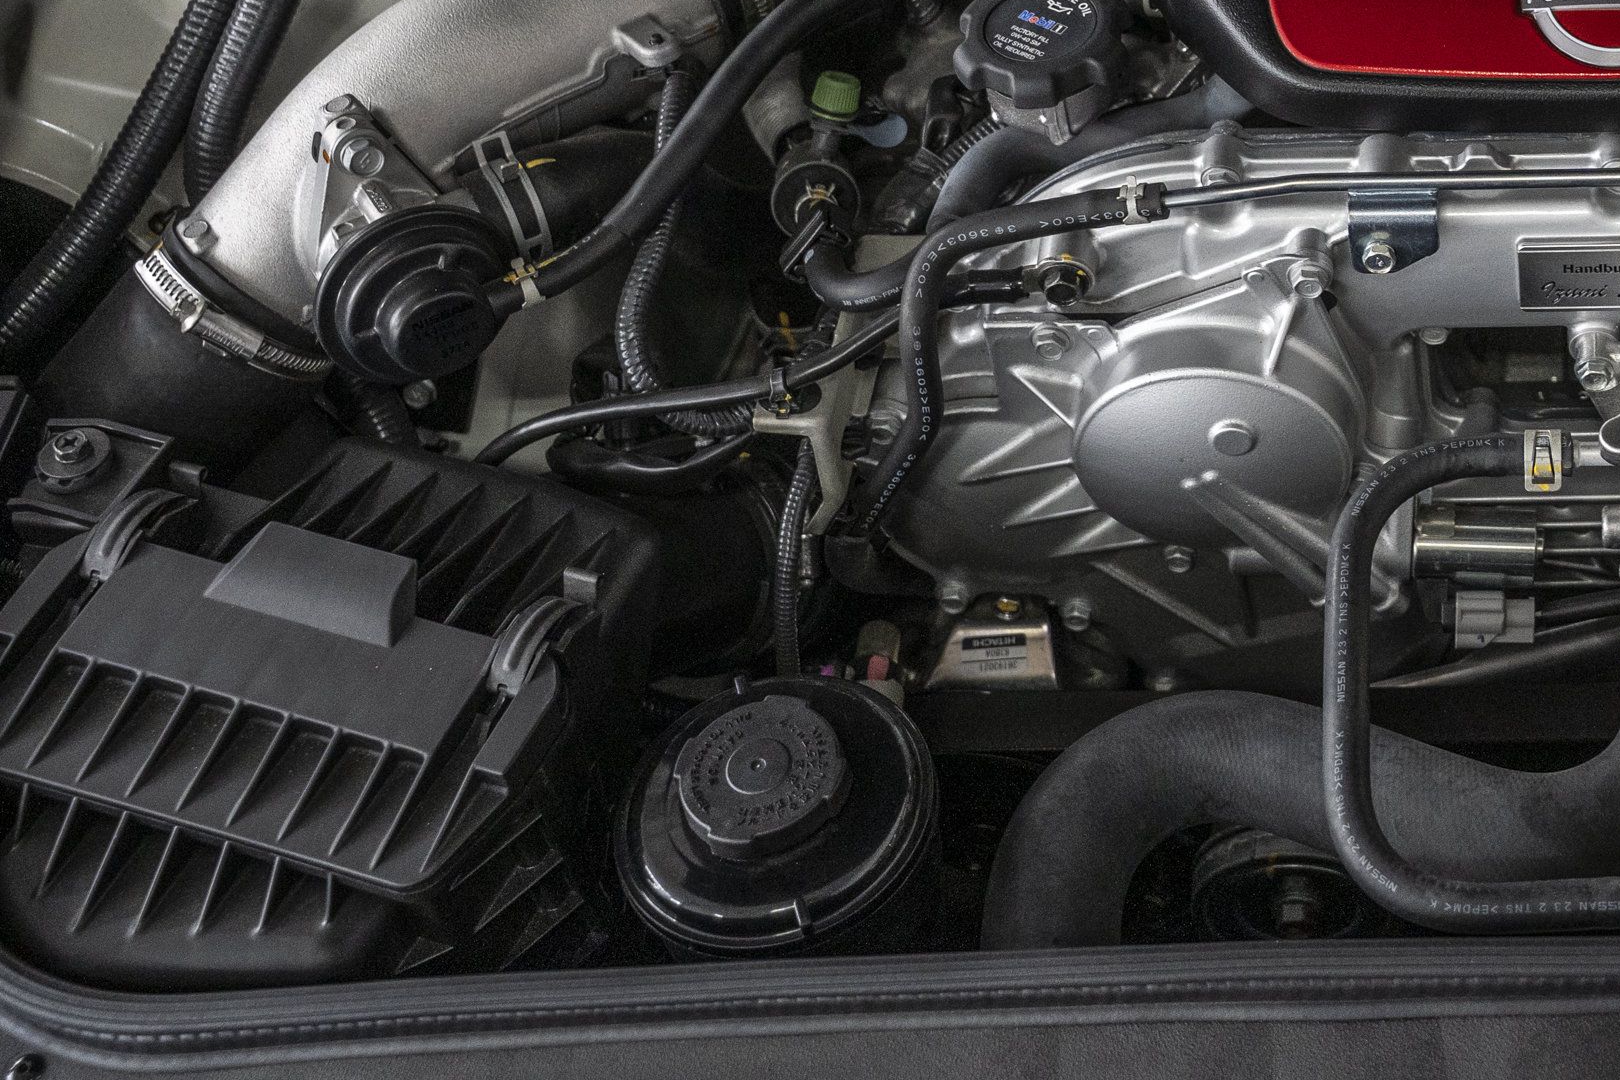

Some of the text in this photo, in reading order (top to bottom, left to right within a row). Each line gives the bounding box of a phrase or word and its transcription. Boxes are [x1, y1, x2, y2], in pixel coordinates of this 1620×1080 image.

[1018, 9, 1056, 30] Mobil
[1078, 2, 1093, 17] OIL
[1010, 25, 1039, 38] FACTORY
[1011, 32, 1030, 42] 0W-40
[994, 34, 1045, 56] FULLY SYNTHETIC
[1005, 45, 1035, 60] REQUIRED
[1540, 281, 1608, 304] Izumi
[1351, 479, 1380, 517] NISSAN
[1412, 446, 1436, 459] TNS
[1441, 439, 1491, 450] >EPDM<
[1498, 438, 1506, 446] K
[1339, 602, 1348, 623] TNS
[972, 636, 1016, 647] HITACHI
[1337, 661, 1347, 703] NISSAN
[1335, 730, 1344, 738] K
[1335, 794, 1346, 819] TNS
[1359, 855, 1397, 892] NISSAN
[1506, 904, 1531, 913] TNS
